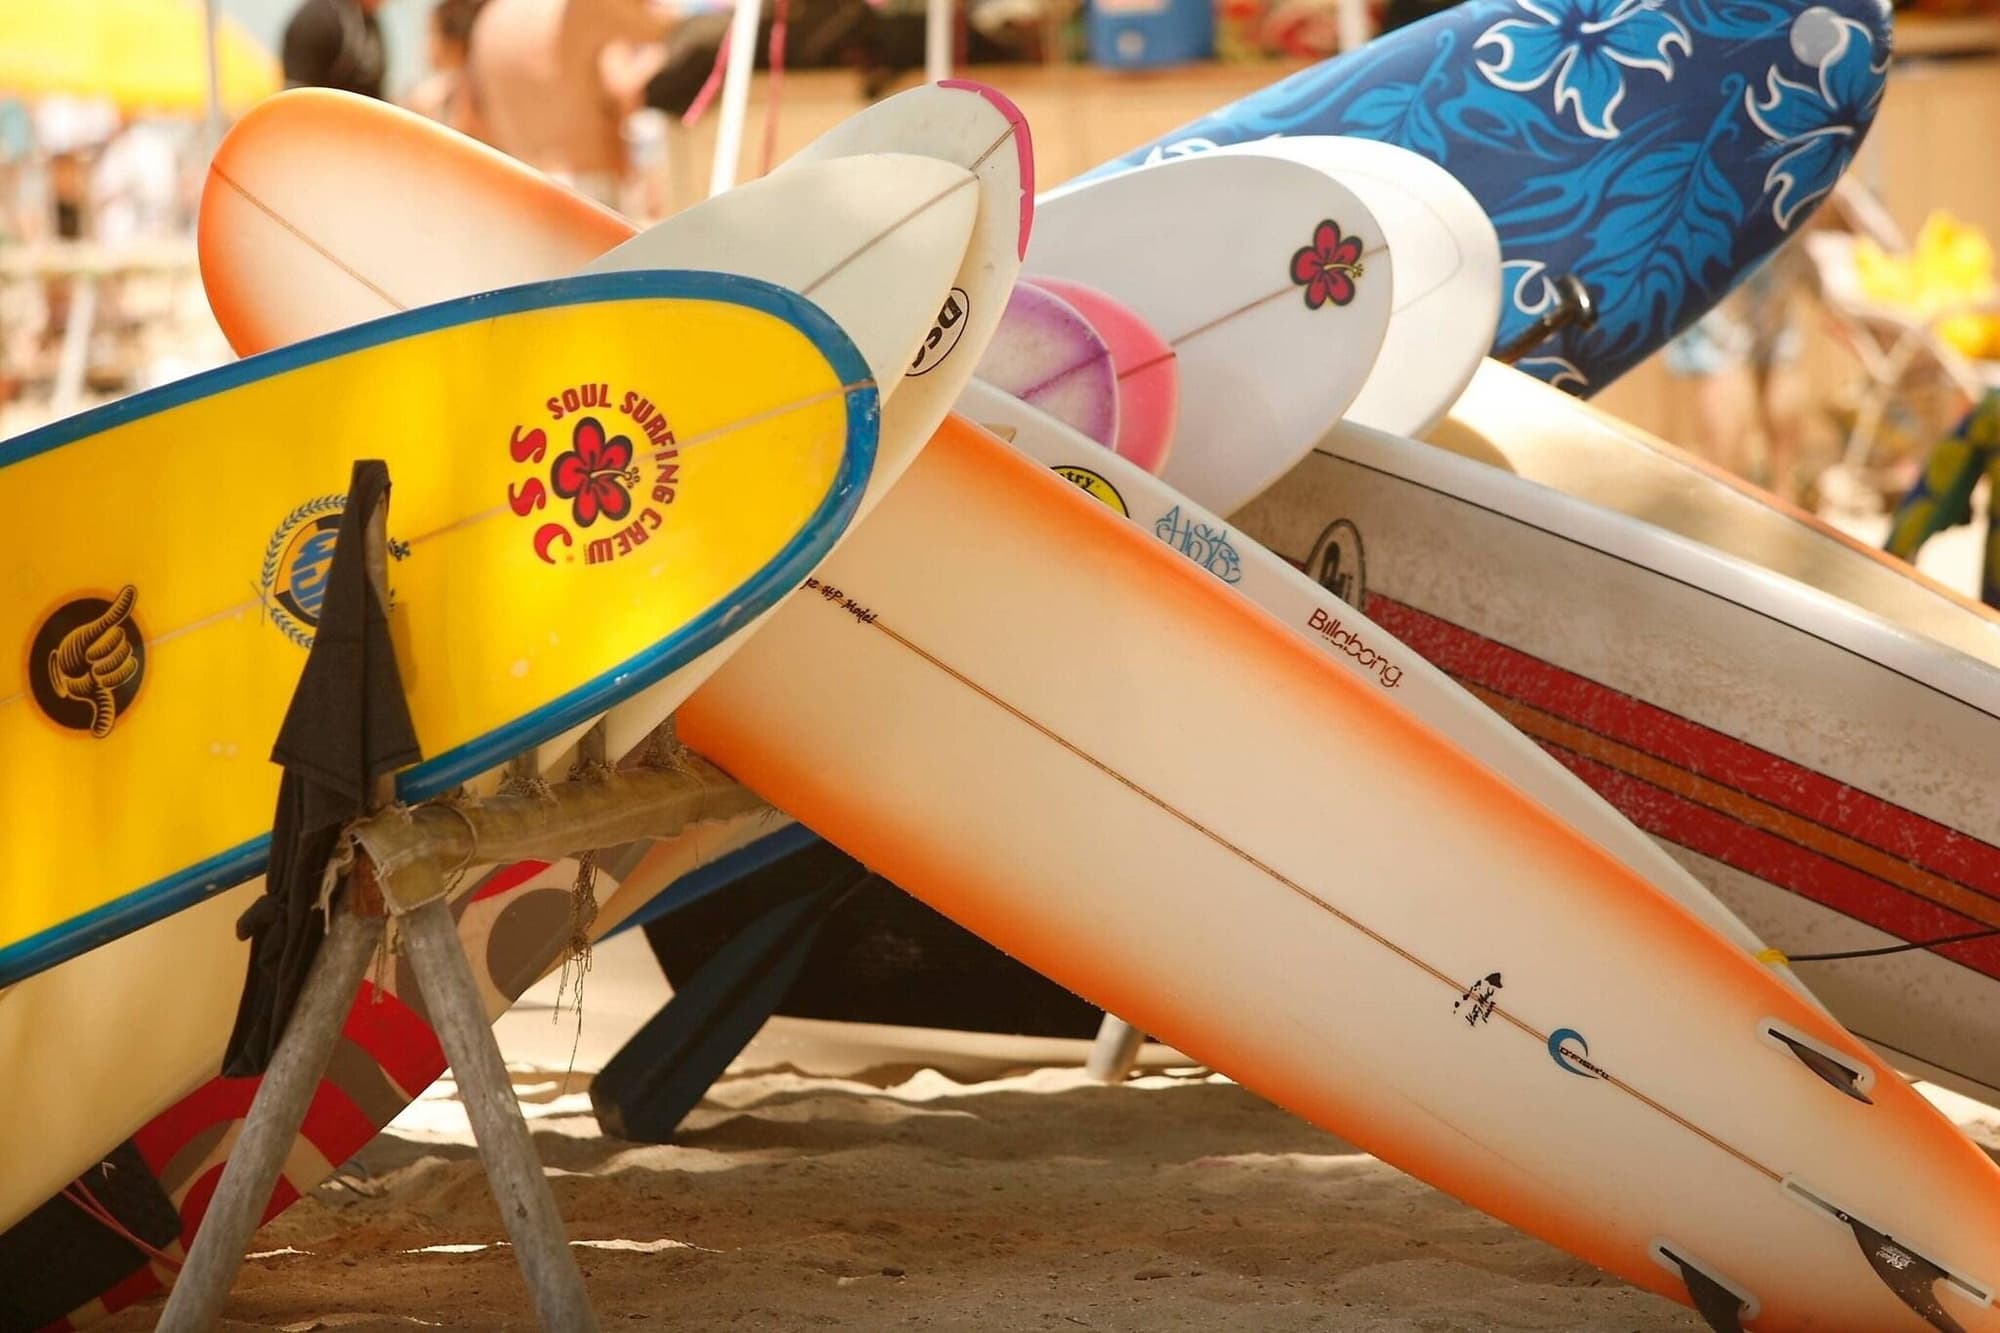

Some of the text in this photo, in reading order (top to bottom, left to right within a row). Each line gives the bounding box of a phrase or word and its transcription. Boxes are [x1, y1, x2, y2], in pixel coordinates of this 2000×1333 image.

[546, 383, 681, 565] SOUL SURFING CREW
[1059, 470, 1095, 489] try
[840, 599, 879, 624] Model
